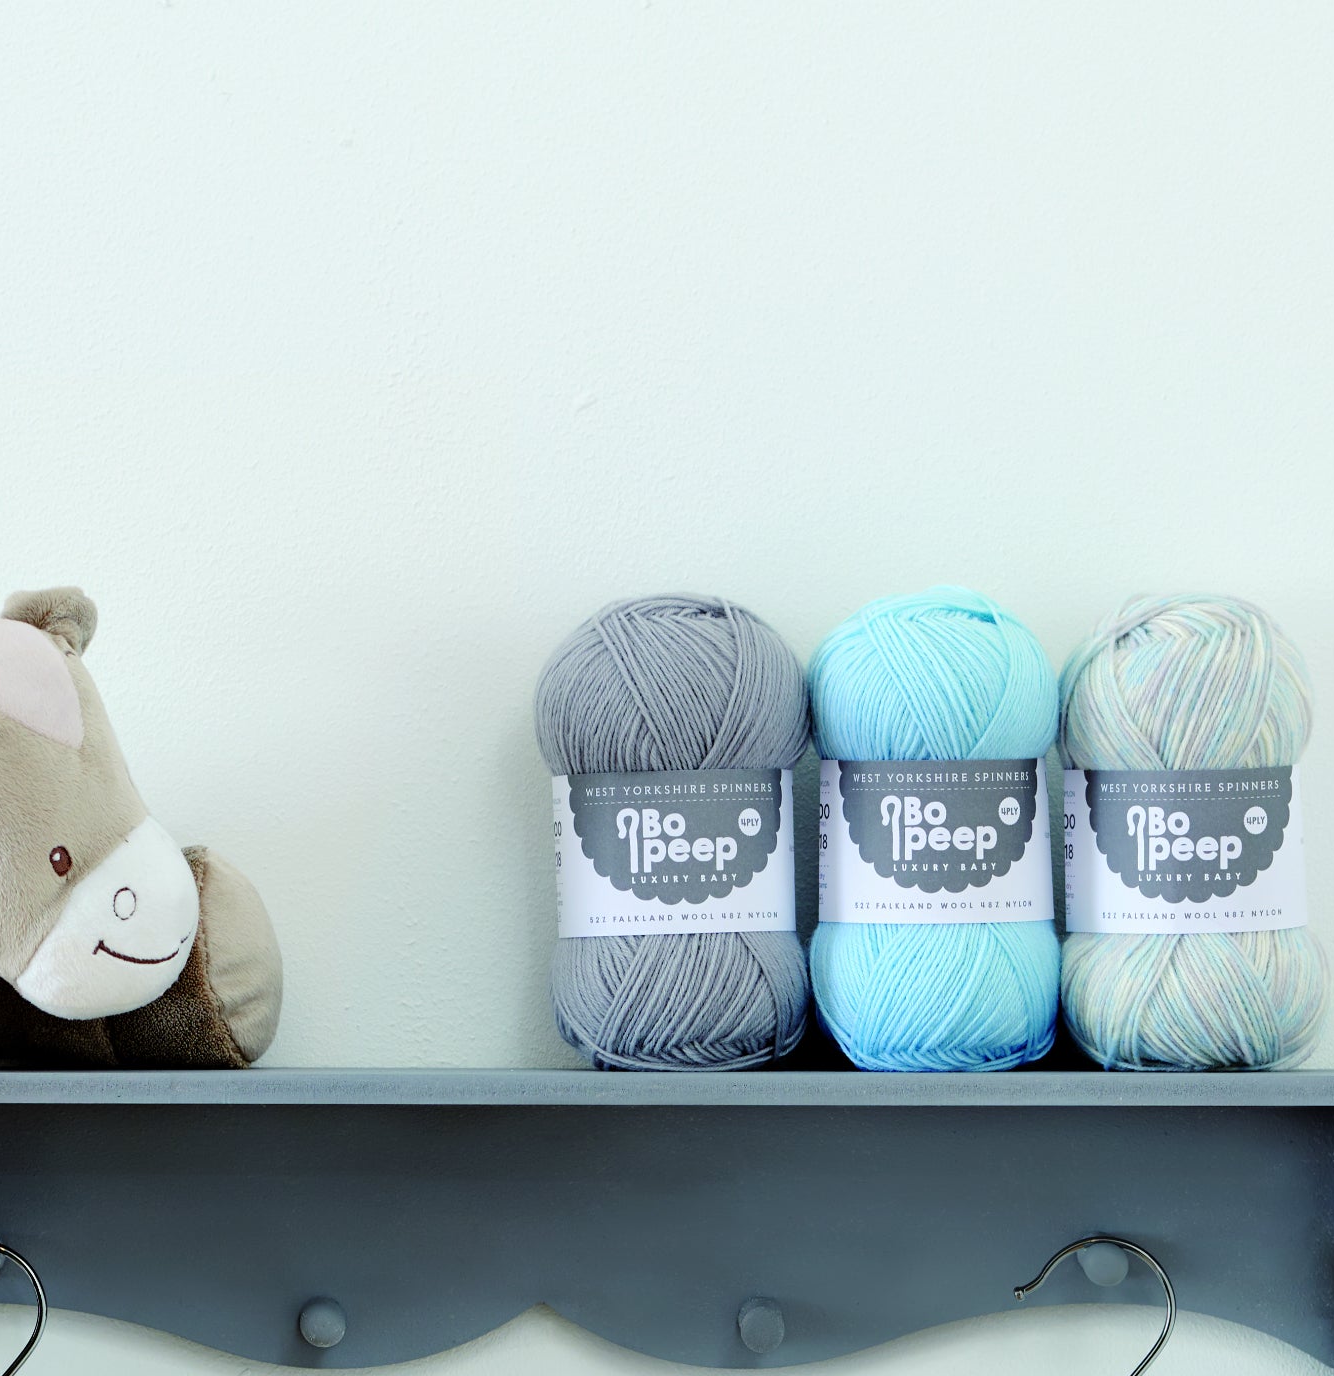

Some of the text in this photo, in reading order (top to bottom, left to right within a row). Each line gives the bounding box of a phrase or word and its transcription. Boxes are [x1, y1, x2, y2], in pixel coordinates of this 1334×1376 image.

[853, 771, 1029, 783] WEST YORKSHIRE SPINNERS
[585, 782, 772, 797] WEST YORKSHIRE SPINNERS
[1100, 779, 1279, 793] WEST YORKSHIRE SPINNERS
[904, 796, 947, 826] Bo
[1001, 806, 1018, 816] 4PLY
[642, 809, 686, 838] Bo
[740, 817, 760, 827] 4PLY
[1148, 806, 1190, 836] Bo
[1246, 816, 1266, 826] 4PLY
[904, 825, 997, 861] peep
[643, 836, 738, 873] peep
[1148, 835, 1242, 871] peep
[893, 862, 997, 872] LUXURY BABY
[631, 873, 738, 884] LUXURY BABY
[1138, 872, 1242, 882] LUXURY BABY
[876, 902, 933, 910] FALKLAND
[1005, 900, 1032, 908] NYLON
[612, 914, 673, 923] FALKLAND
[681, 913, 715, 921] WOOL
[748, 911, 778, 919] NYLON
[1122, 912, 1176, 920] FALKLAND
[1251, 908, 1282, 918] NYLON
